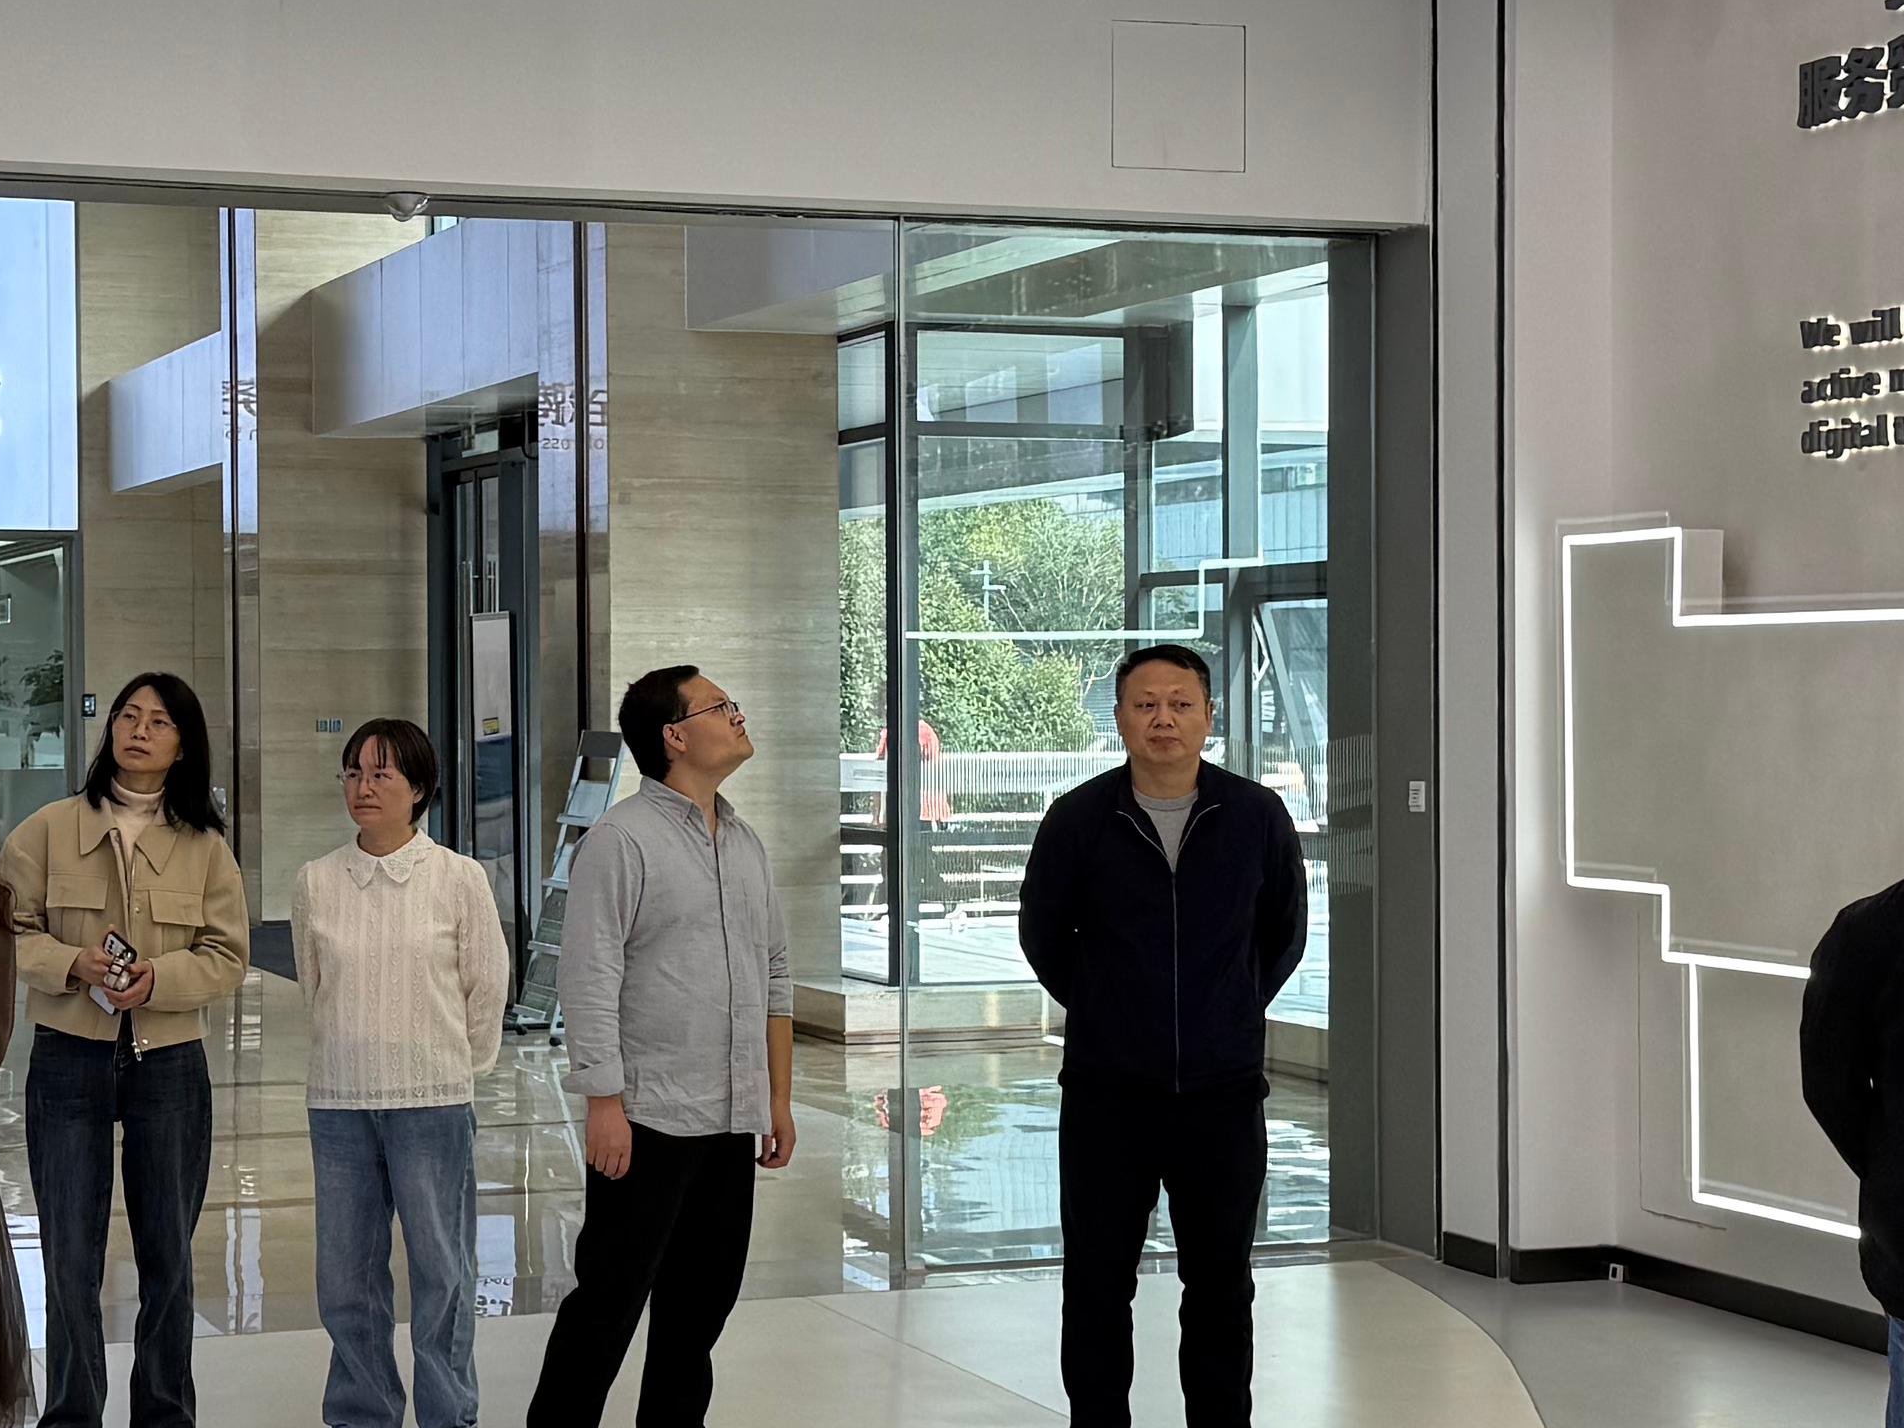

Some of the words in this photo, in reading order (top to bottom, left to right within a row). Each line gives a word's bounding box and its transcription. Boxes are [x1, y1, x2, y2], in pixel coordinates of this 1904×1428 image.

[1800, 317, 1841, 349] We
[1849, 307, 1903, 346] will
[1800, 368, 1881, 403] active
[1801, 414, 1888, 459] digital
